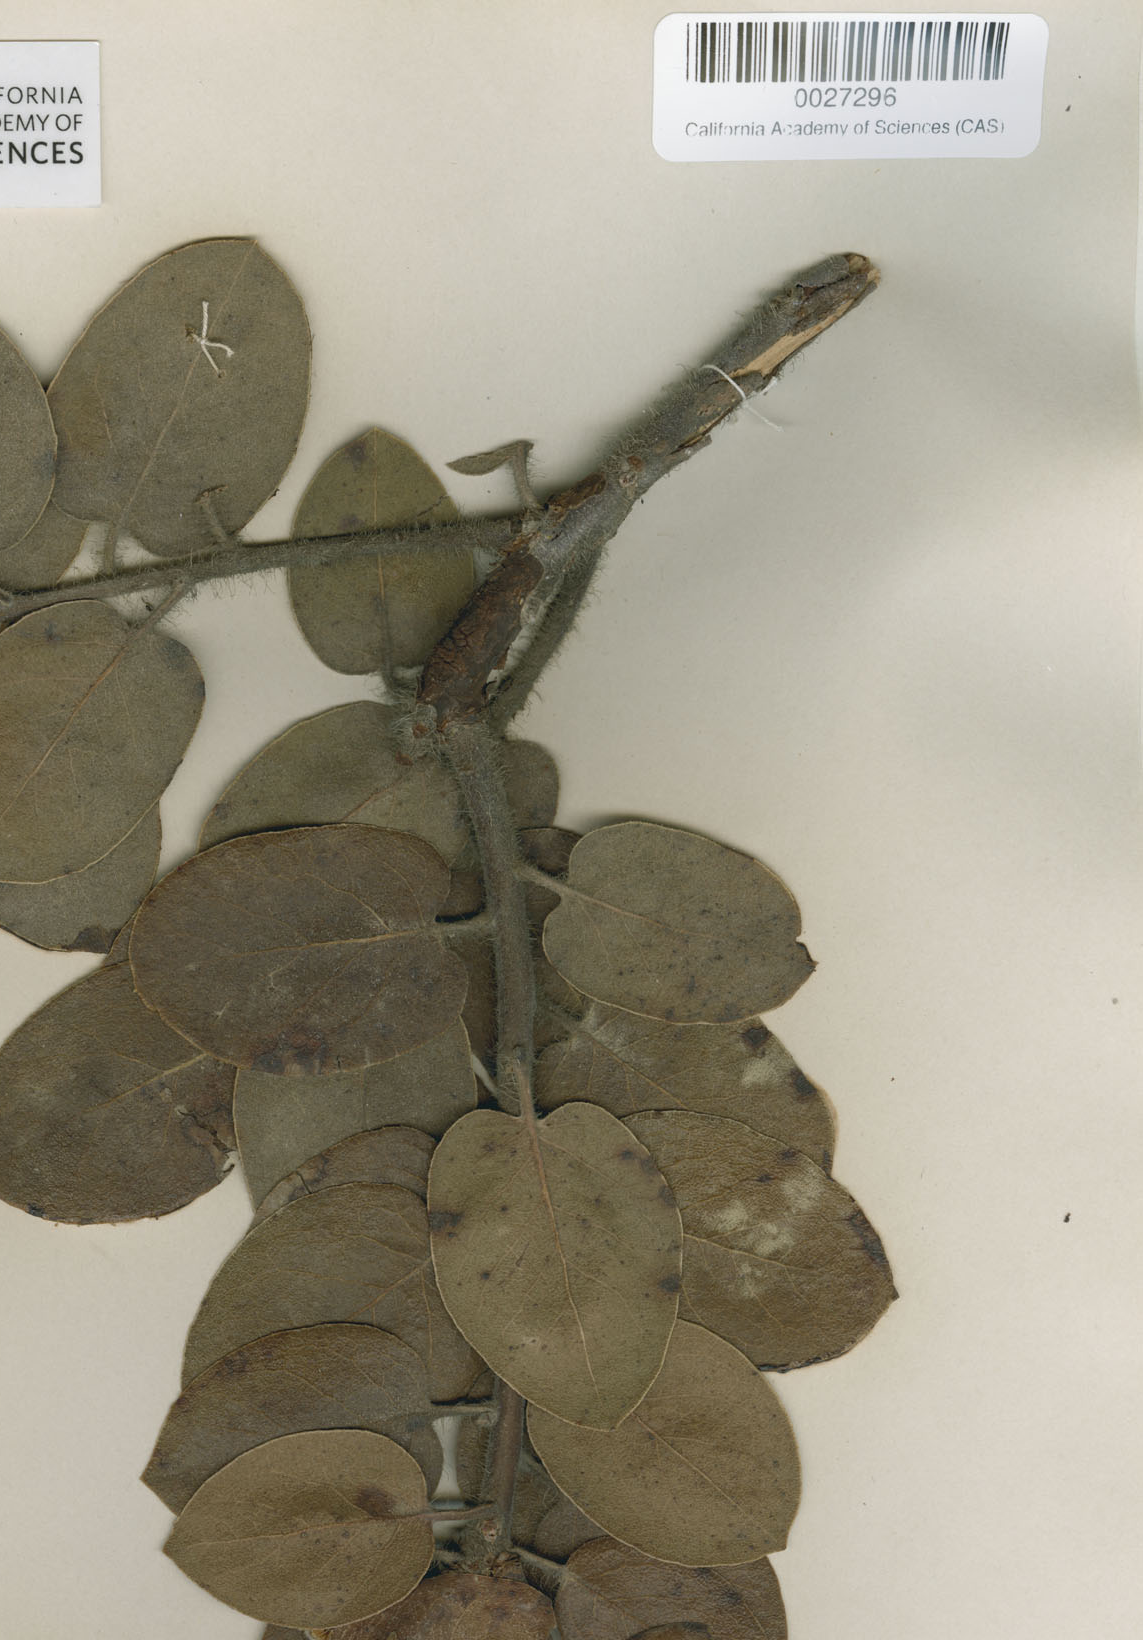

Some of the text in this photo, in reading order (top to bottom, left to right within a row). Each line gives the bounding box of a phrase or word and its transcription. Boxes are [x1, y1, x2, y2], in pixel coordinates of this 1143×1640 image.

[794, 87, 897, 108] 0027296
[55, 115, 83, 132] OF
[685, 118, 1005, 138] California Academy of Sciences (CAS)
